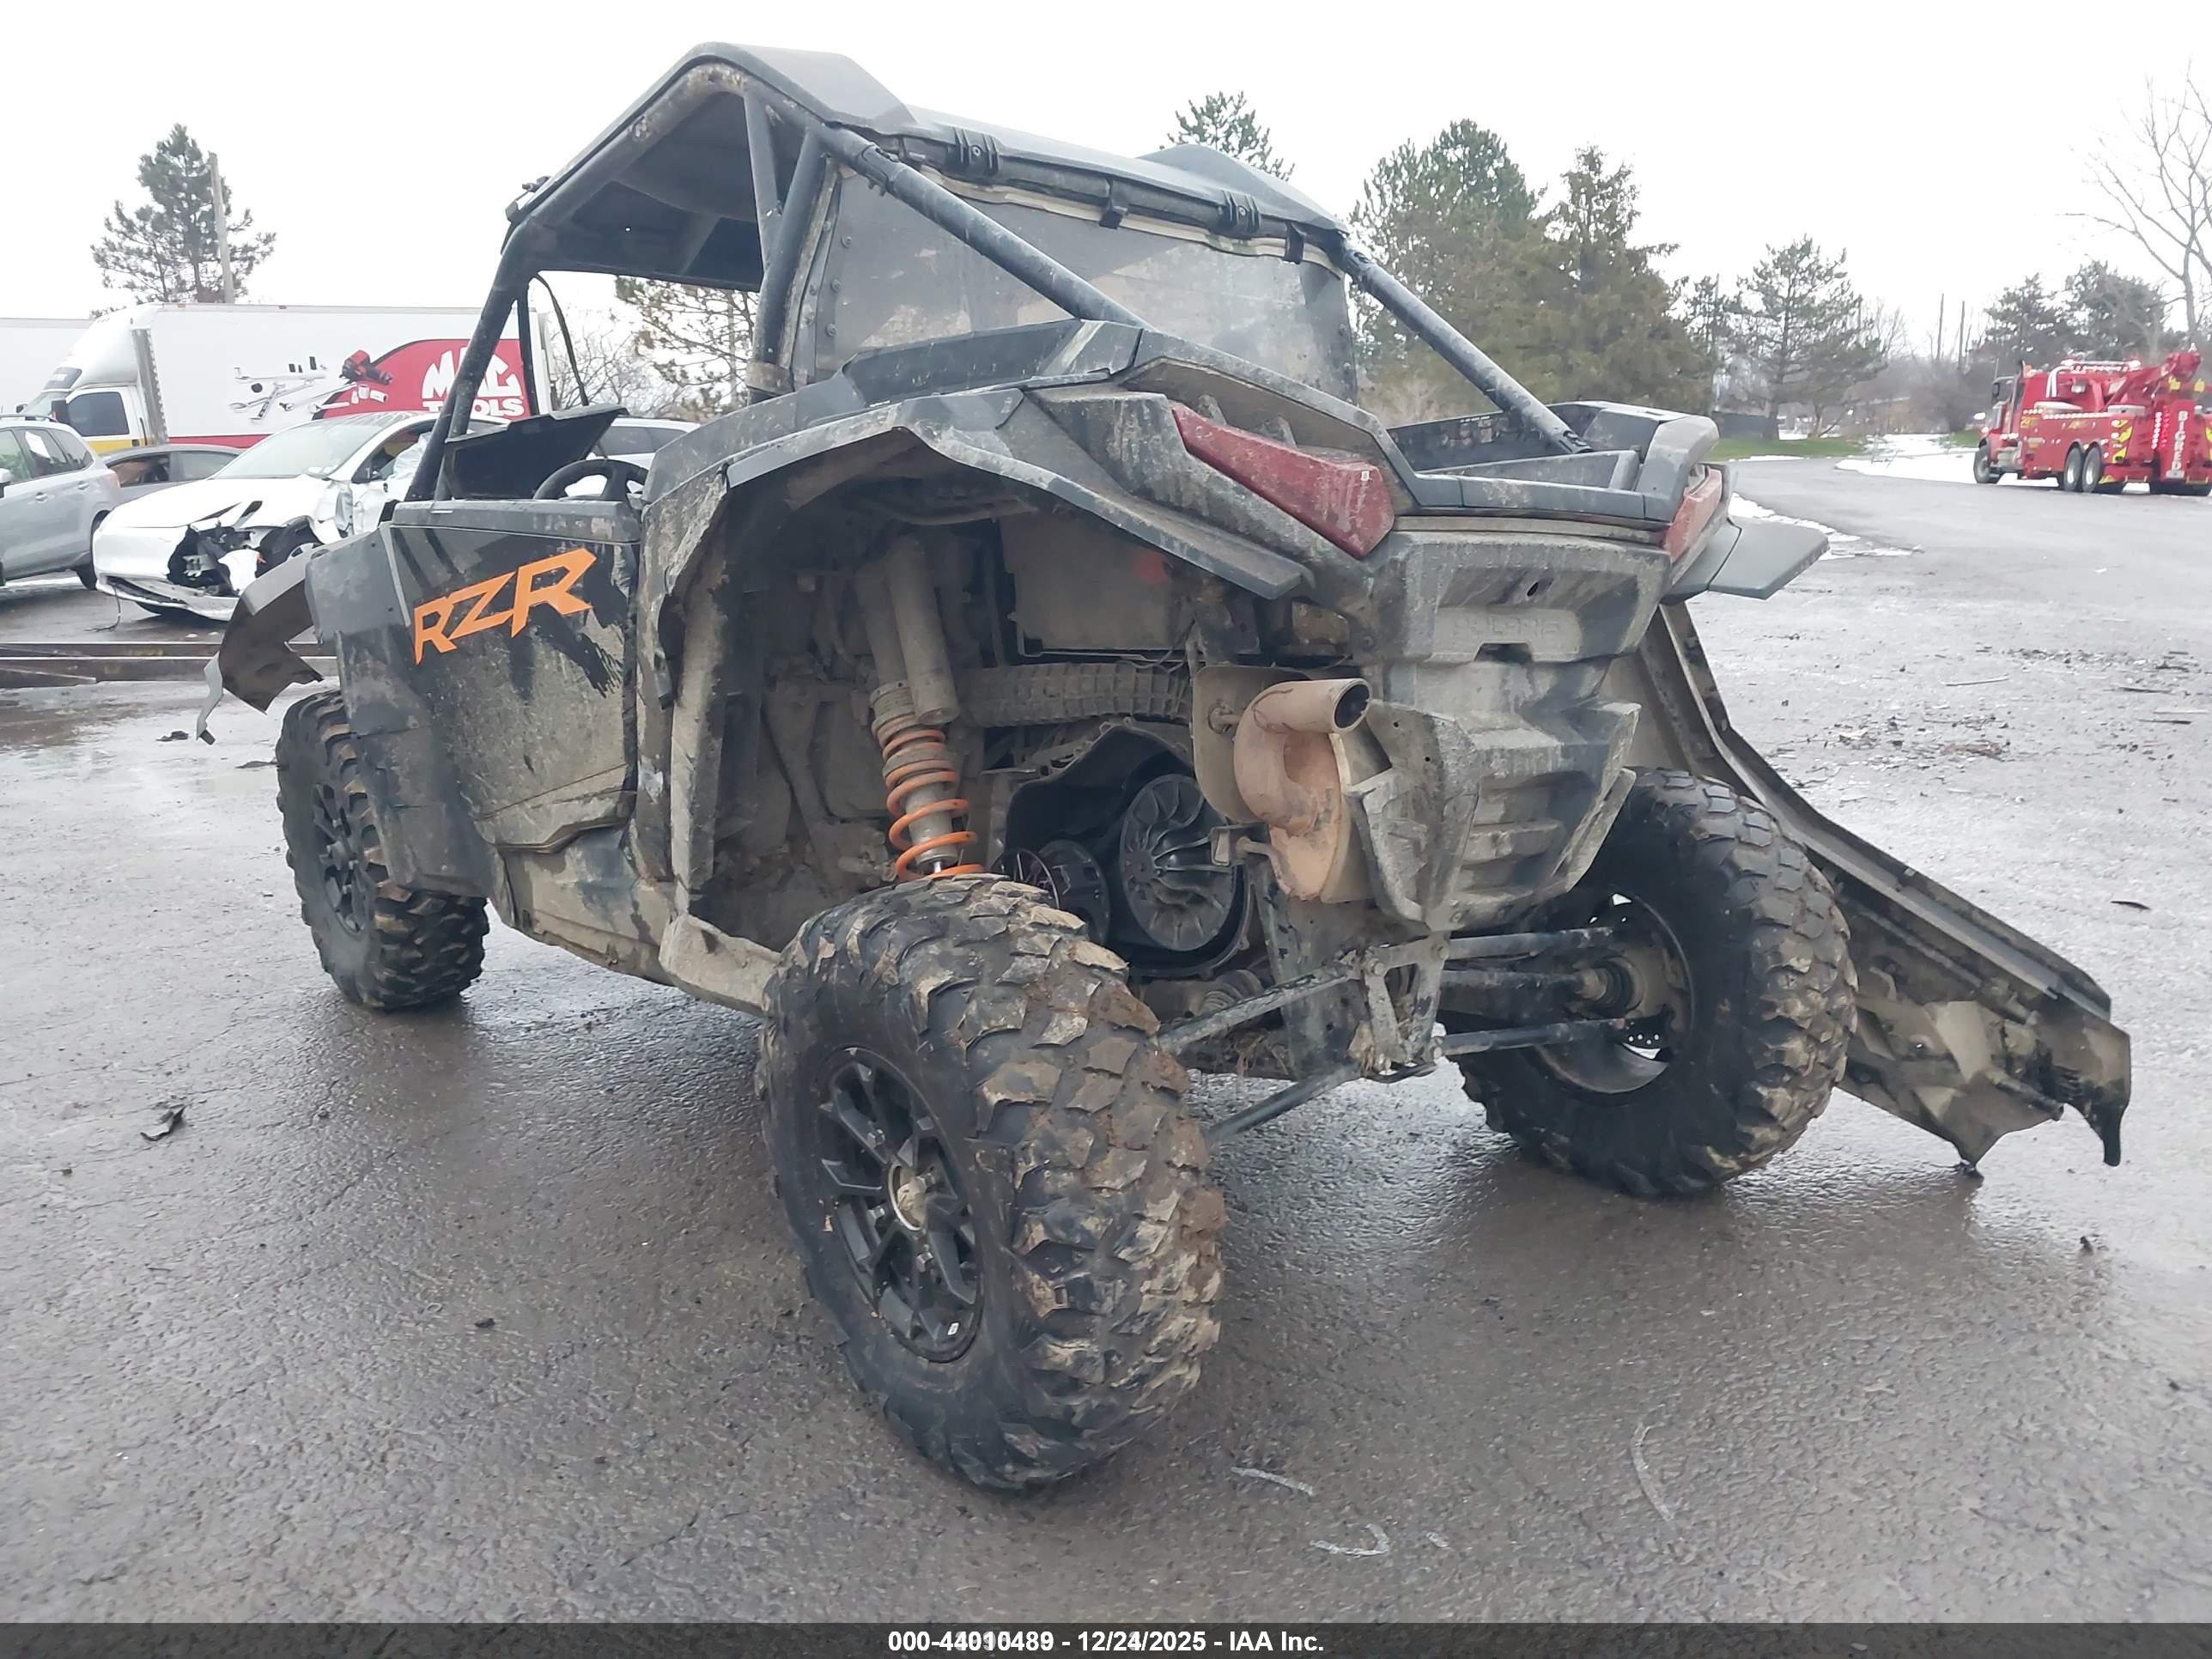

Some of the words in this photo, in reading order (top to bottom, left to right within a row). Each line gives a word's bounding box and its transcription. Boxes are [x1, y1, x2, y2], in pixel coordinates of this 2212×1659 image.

[422, 346, 522, 398] MC
[422, 398, 525, 416] TOLS
[414, 548, 598, 665] RZR
